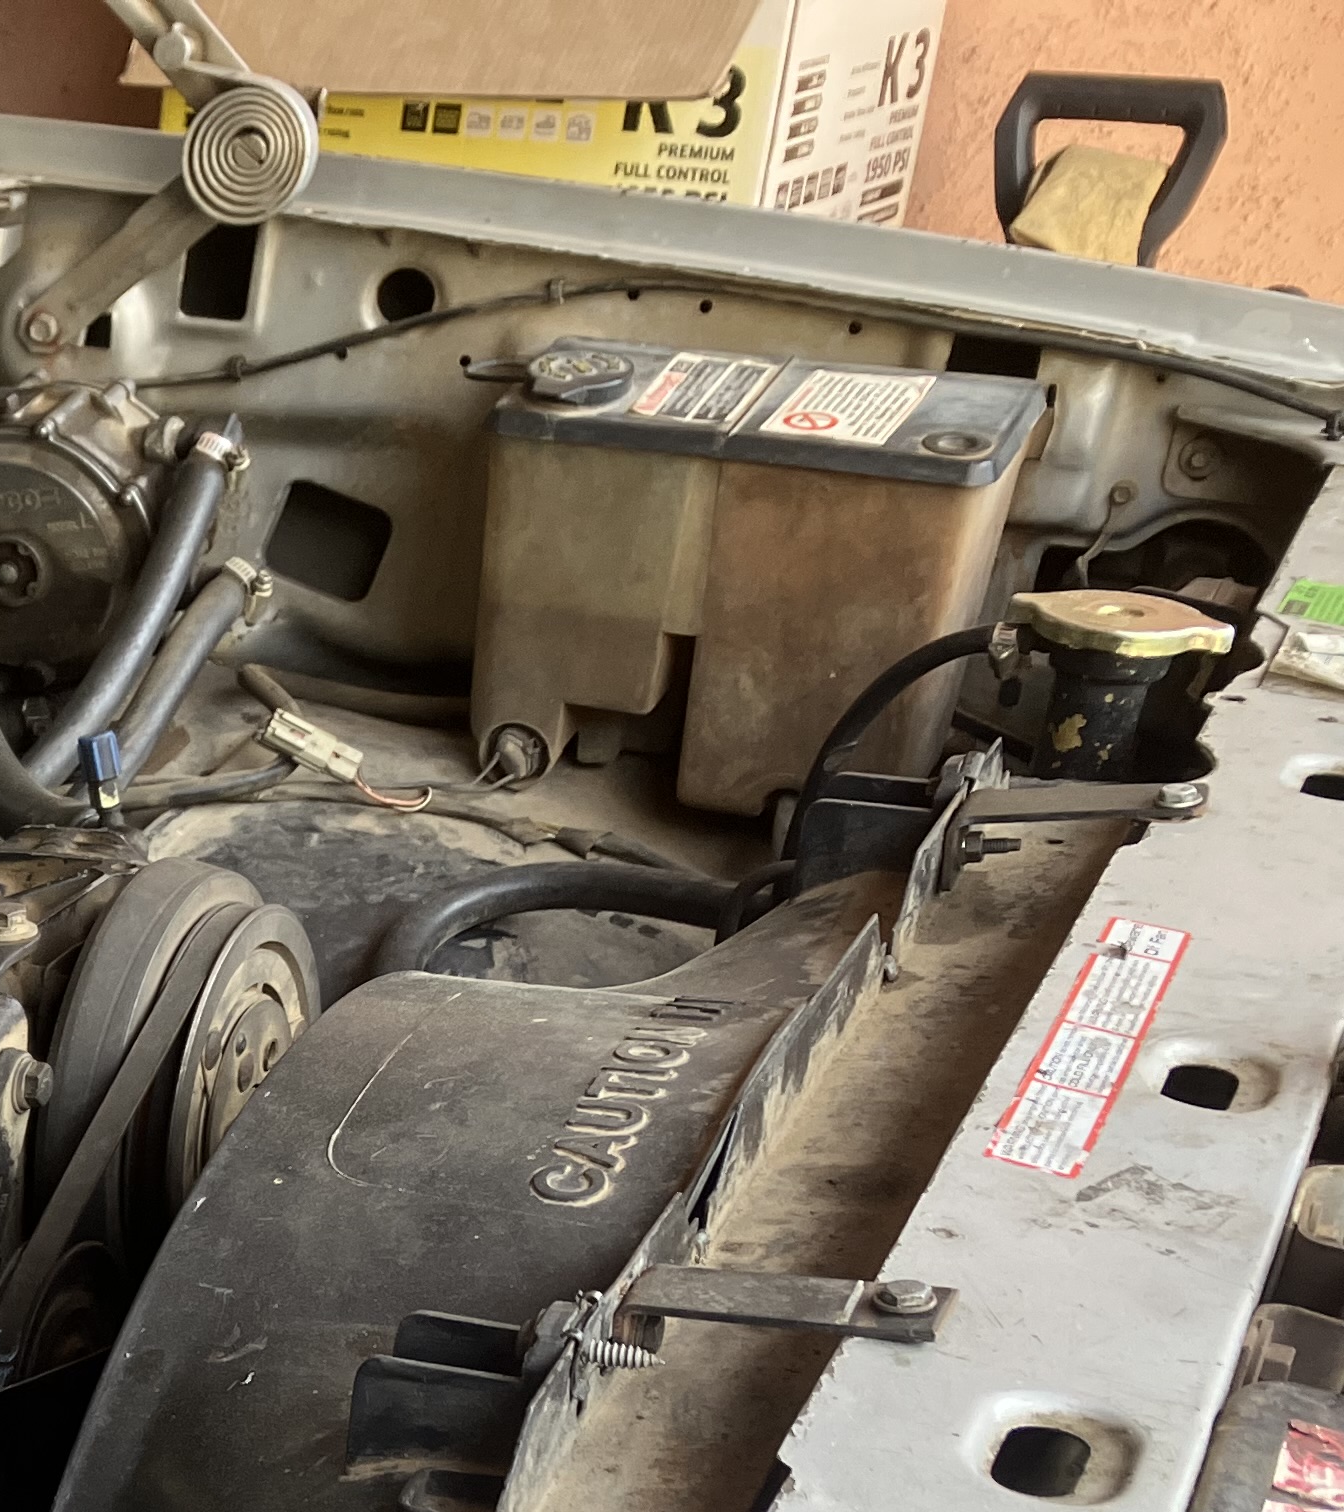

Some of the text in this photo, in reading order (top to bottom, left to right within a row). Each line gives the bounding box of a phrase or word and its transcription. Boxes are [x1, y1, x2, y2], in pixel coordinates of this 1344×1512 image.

[657, 142, 735, 162] PREMIUM
[613, 161, 730, 185] FULL CONTROL
[864, 151, 893, 184] 1950
[529, 1025, 709, 1207] CAUTION
